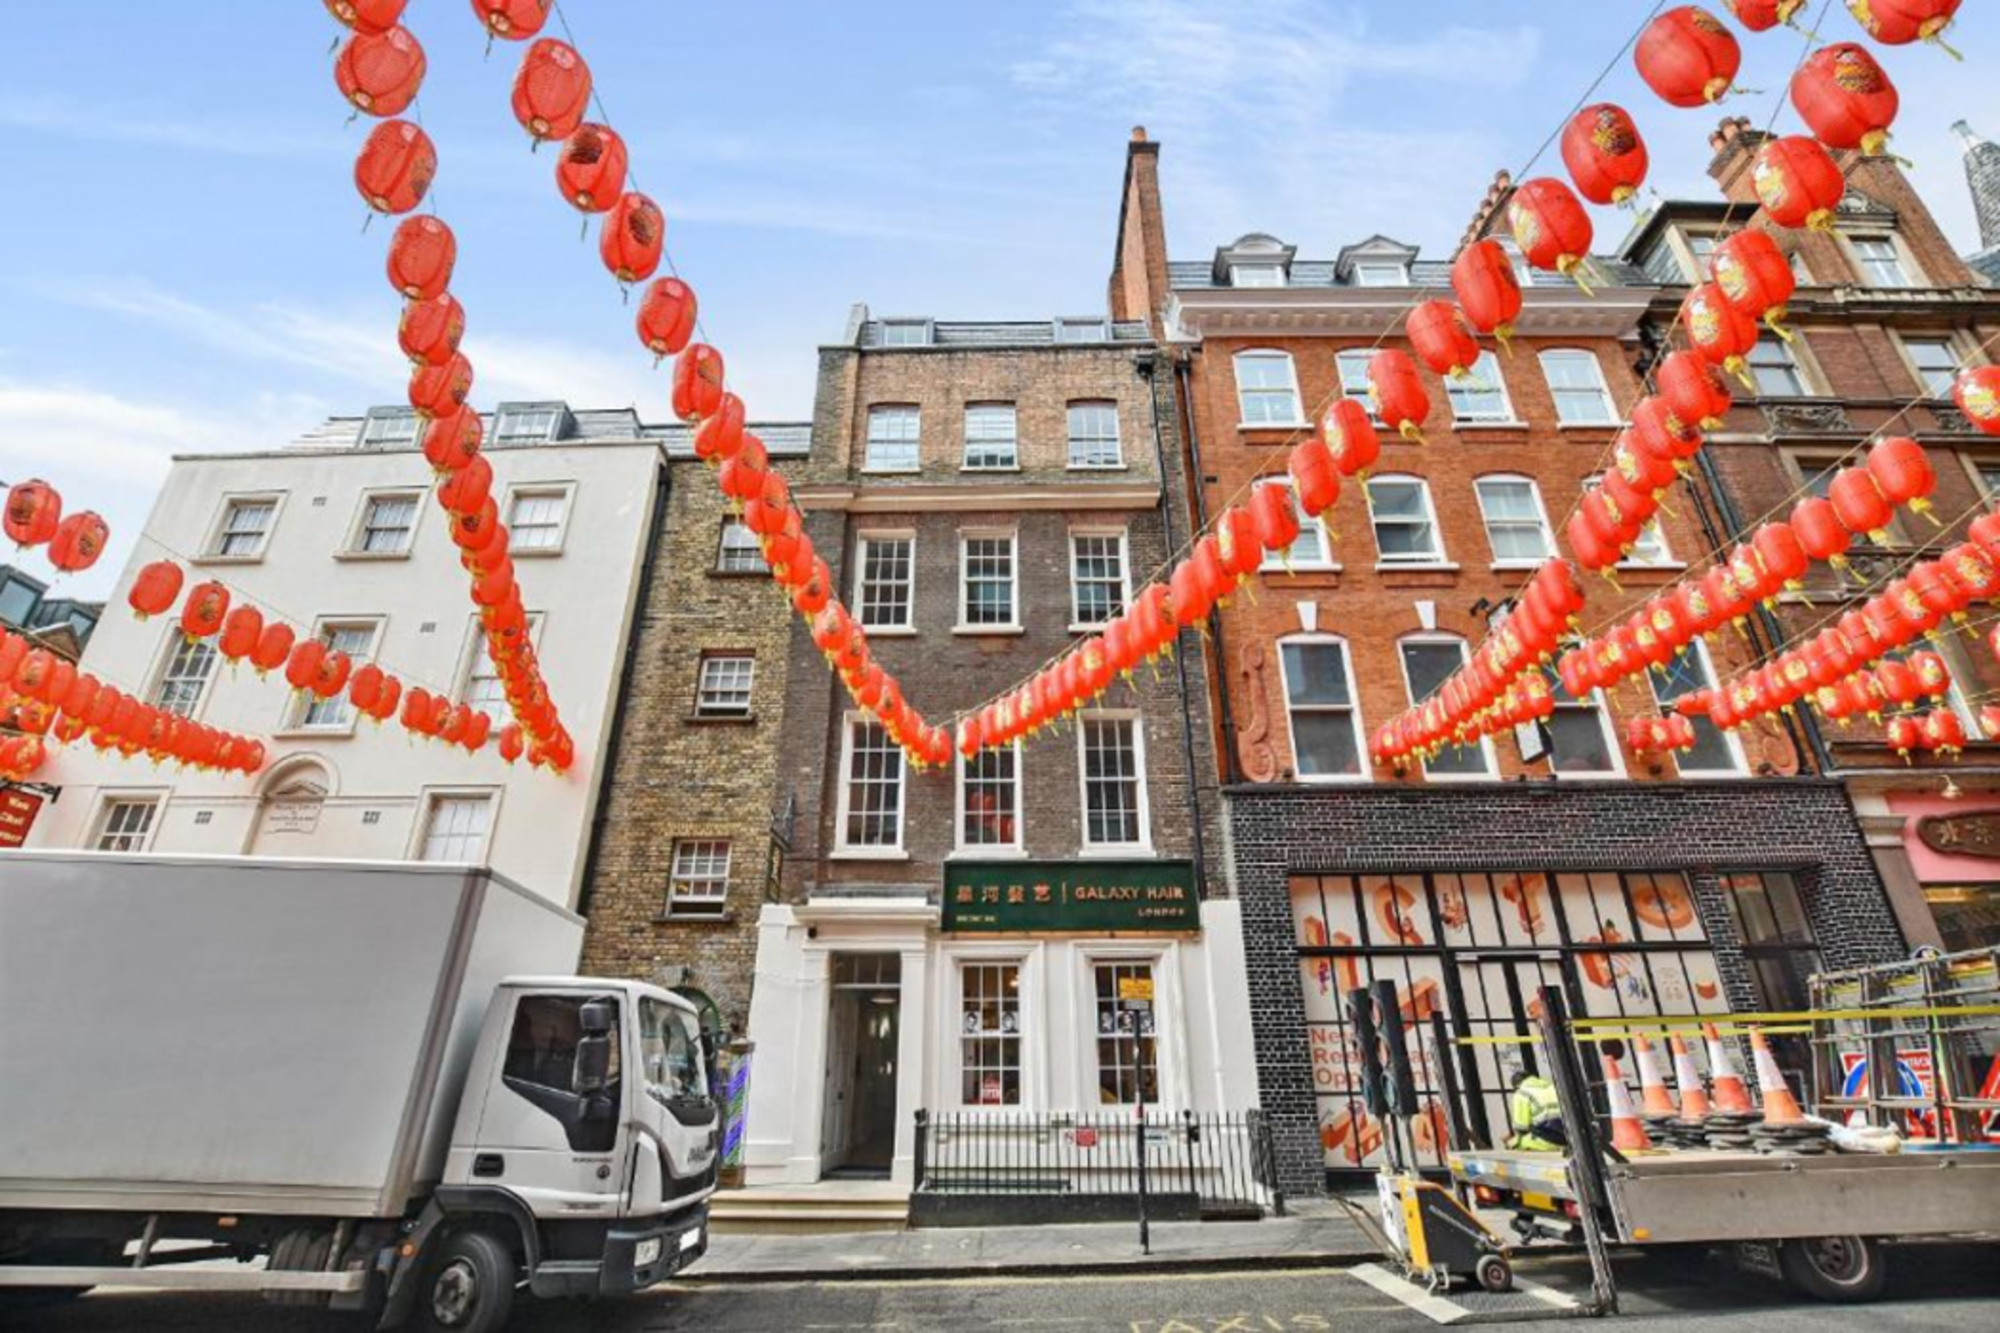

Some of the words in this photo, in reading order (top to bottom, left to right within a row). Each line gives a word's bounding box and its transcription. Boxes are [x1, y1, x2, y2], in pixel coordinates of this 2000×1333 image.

[1075, 886, 1139, 899] GALAXY
[1147, 886, 1184, 899] HAIR
[1130, 1315, 1331, 1333] TAXIS
